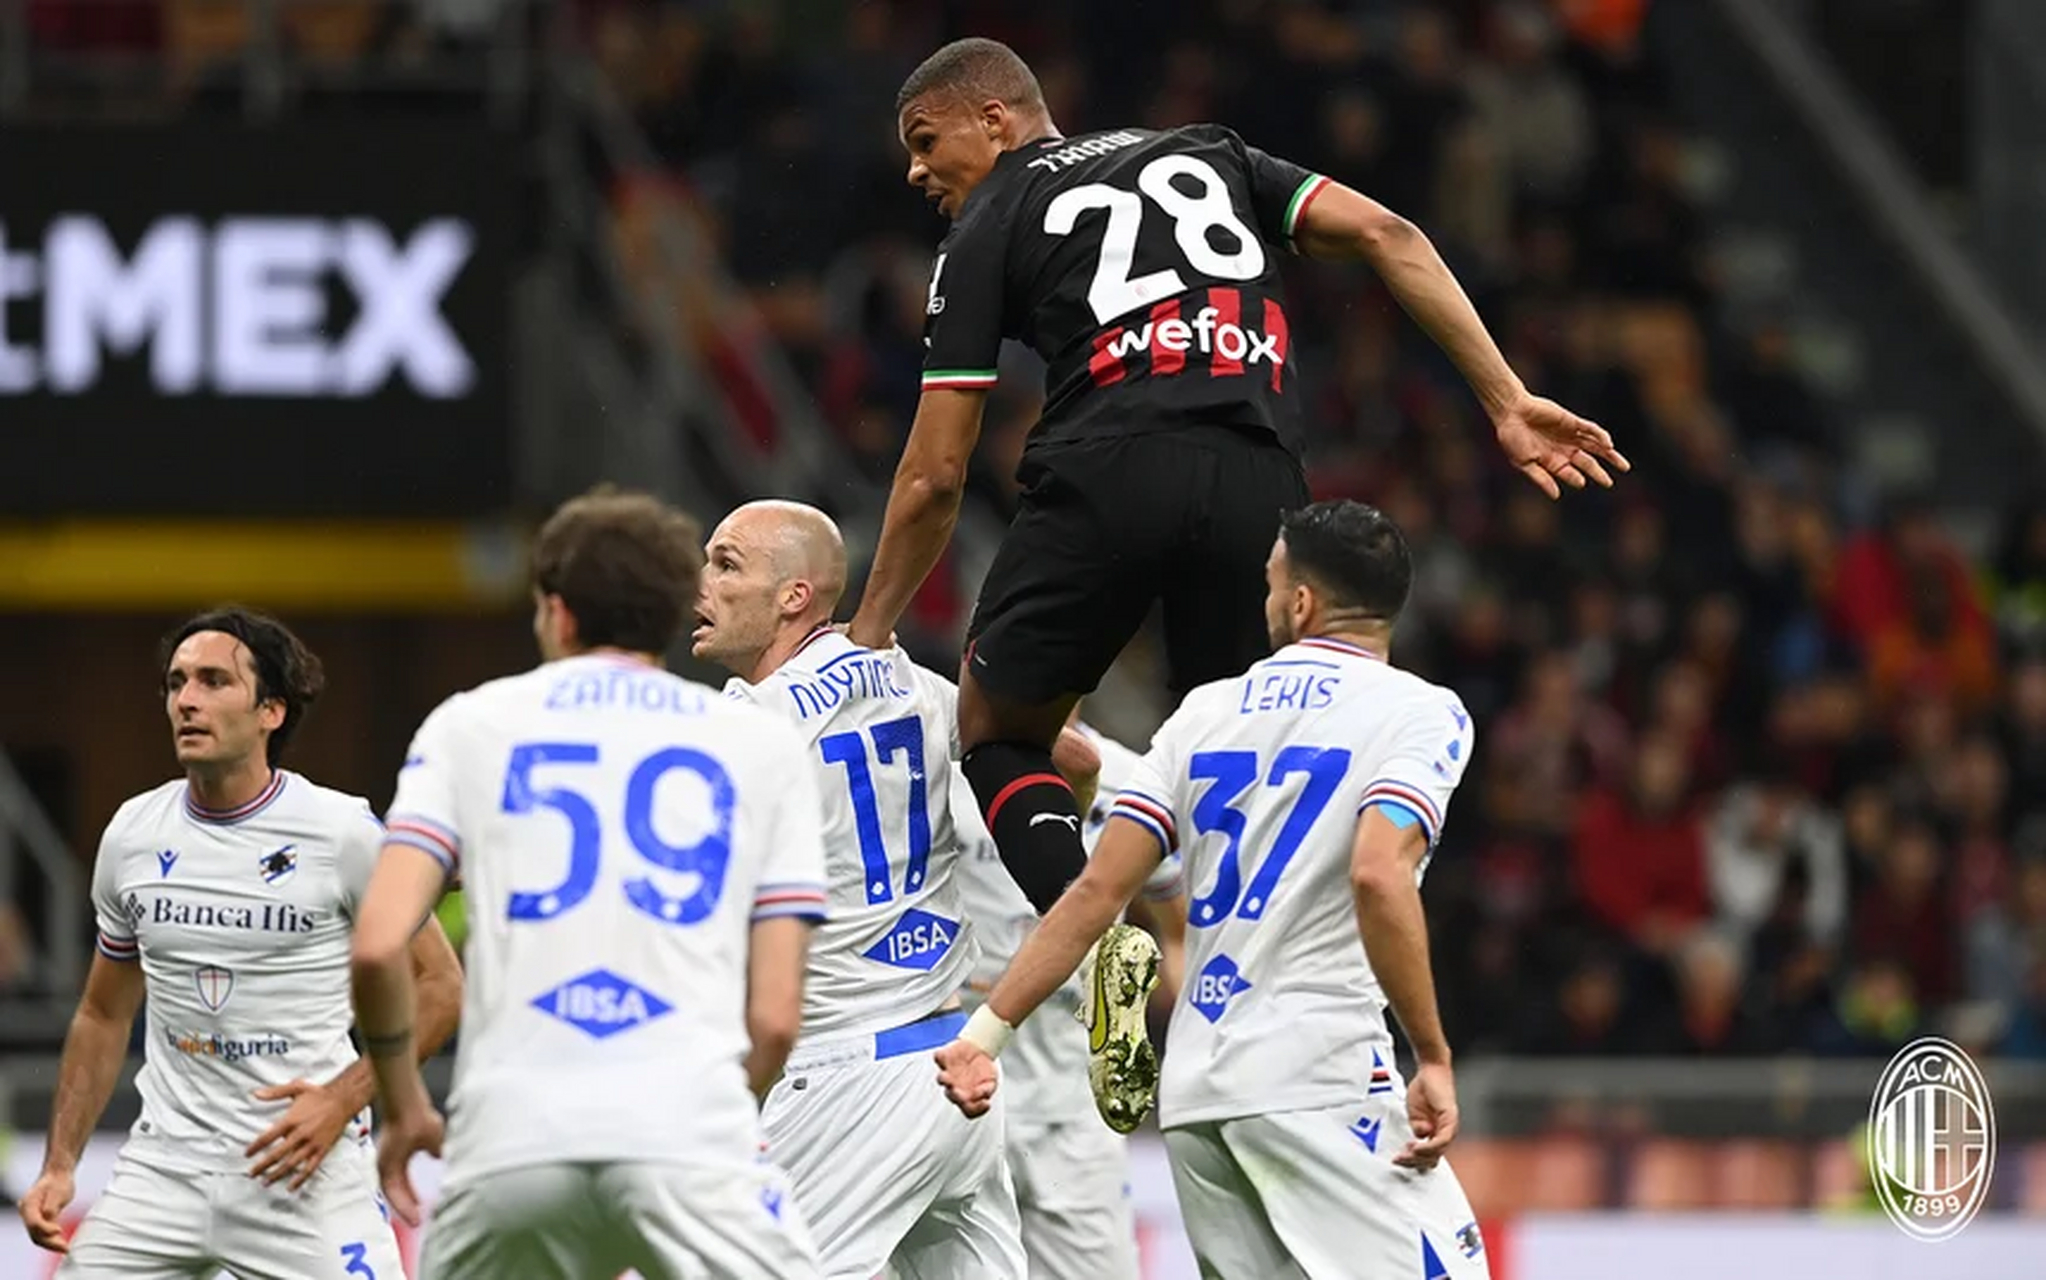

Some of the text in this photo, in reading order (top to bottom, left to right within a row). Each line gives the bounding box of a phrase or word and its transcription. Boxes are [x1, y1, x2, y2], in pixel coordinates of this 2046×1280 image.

[1044, 154, 1265, 326] 28
[1106, 307, 1284, 364] wefox
[501, 742, 735, 925] 59
[819, 714, 931, 906] 17
[1188, 745, 1352, 928] 37
[153, 897, 315, 933] Banca Ifis
[888, 920, 950, 962] IBSA
[556, 983, 648, 1025] IBSA
